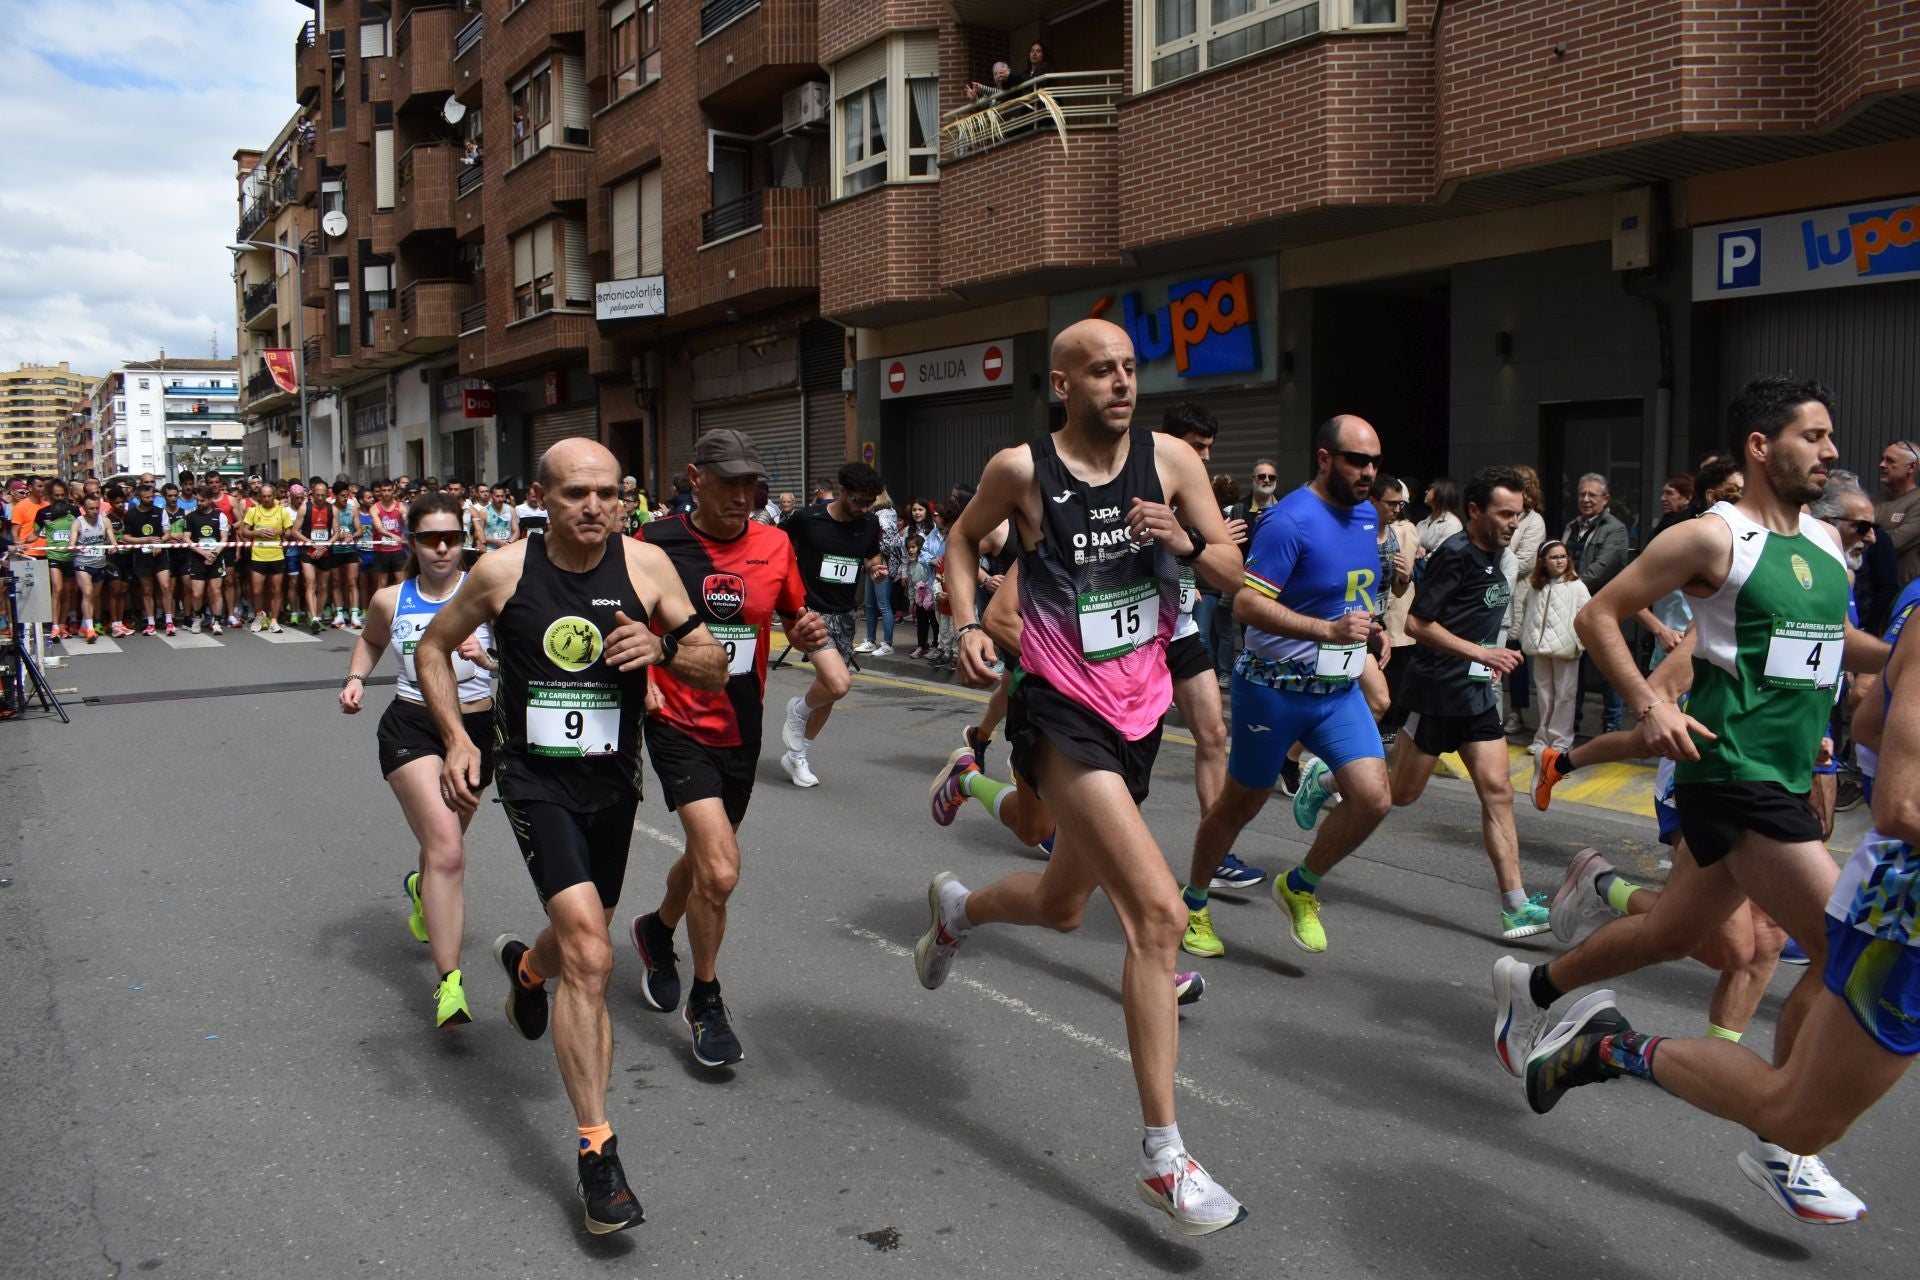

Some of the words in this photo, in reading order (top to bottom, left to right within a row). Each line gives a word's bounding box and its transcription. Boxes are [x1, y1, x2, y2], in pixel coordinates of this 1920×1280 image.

[1800, 206, 1920, 273] lupa
[1722, 235, 1756, 285] P
[1122, 271, 1254, 373] lupa
[919, 359, 967, 383] SALIDA
[834, 564, 848, 577] 10
[706, 593, 741, 602] LODOSA
[1089, 595, 1099, 603] XV
[1099, 590, 1129, 601] CARRERA
[1129, 582, 1151, 595] POPULAR
[1344, 568, 1375, 615] R
[1111, 604, 1140, 639] 15
[1796, 622, 1824, 630] CARRERA
[1342, 650, 1353, 670] 7
[1806, 642, 1823, 672] 4
[528, 680, 618, 689] www.calagurrisatletico.es
[538, 691, 547, 699] XV
[549, 692, 580, 700] CARRERA
[564, 710, 584, 740] 9
